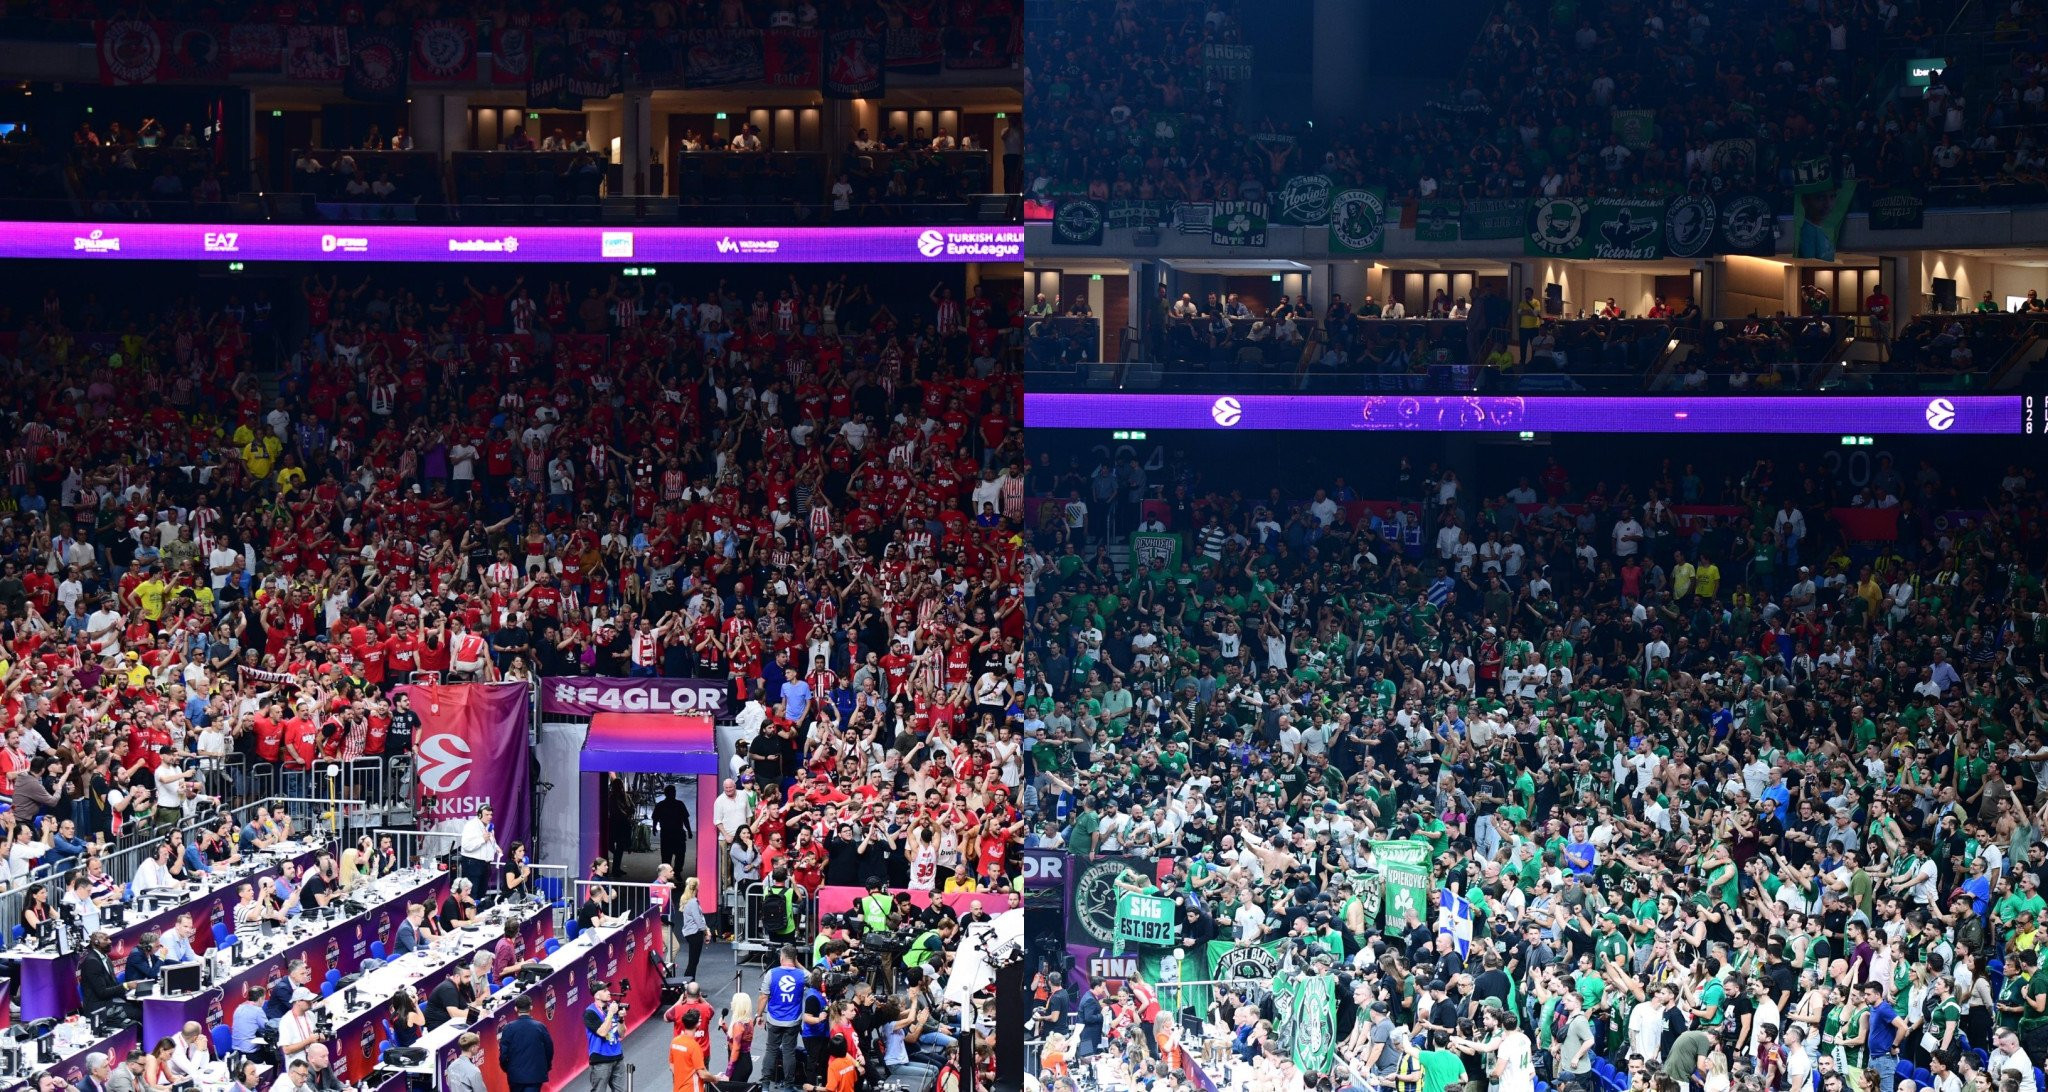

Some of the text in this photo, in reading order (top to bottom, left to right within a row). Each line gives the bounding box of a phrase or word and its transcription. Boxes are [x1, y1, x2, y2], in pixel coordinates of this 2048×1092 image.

[204, 233, 239, 247] EA7
[948, 234, 994, 243] TURKISH
[1213, 233, 1264, 246] GATE 13
[947, 243, 1020, 257] EuroLeague
[949, 661, 967, 669] bwin
[555, 683, 728, 710] #F4GLOR
[417, 796, 491, 815] RKISH
[917, 862, 935, 878] 33
[1024, 857, 1063, 878] OR
[1130, 897, 1162, 918] SKG
[1121, 918, 1171, 940] EST.1972
[1221, 948, 1248, 969] WEST
[1091, 958, 1139, 978] FINA
[780, 993, 794, 1003] TV
